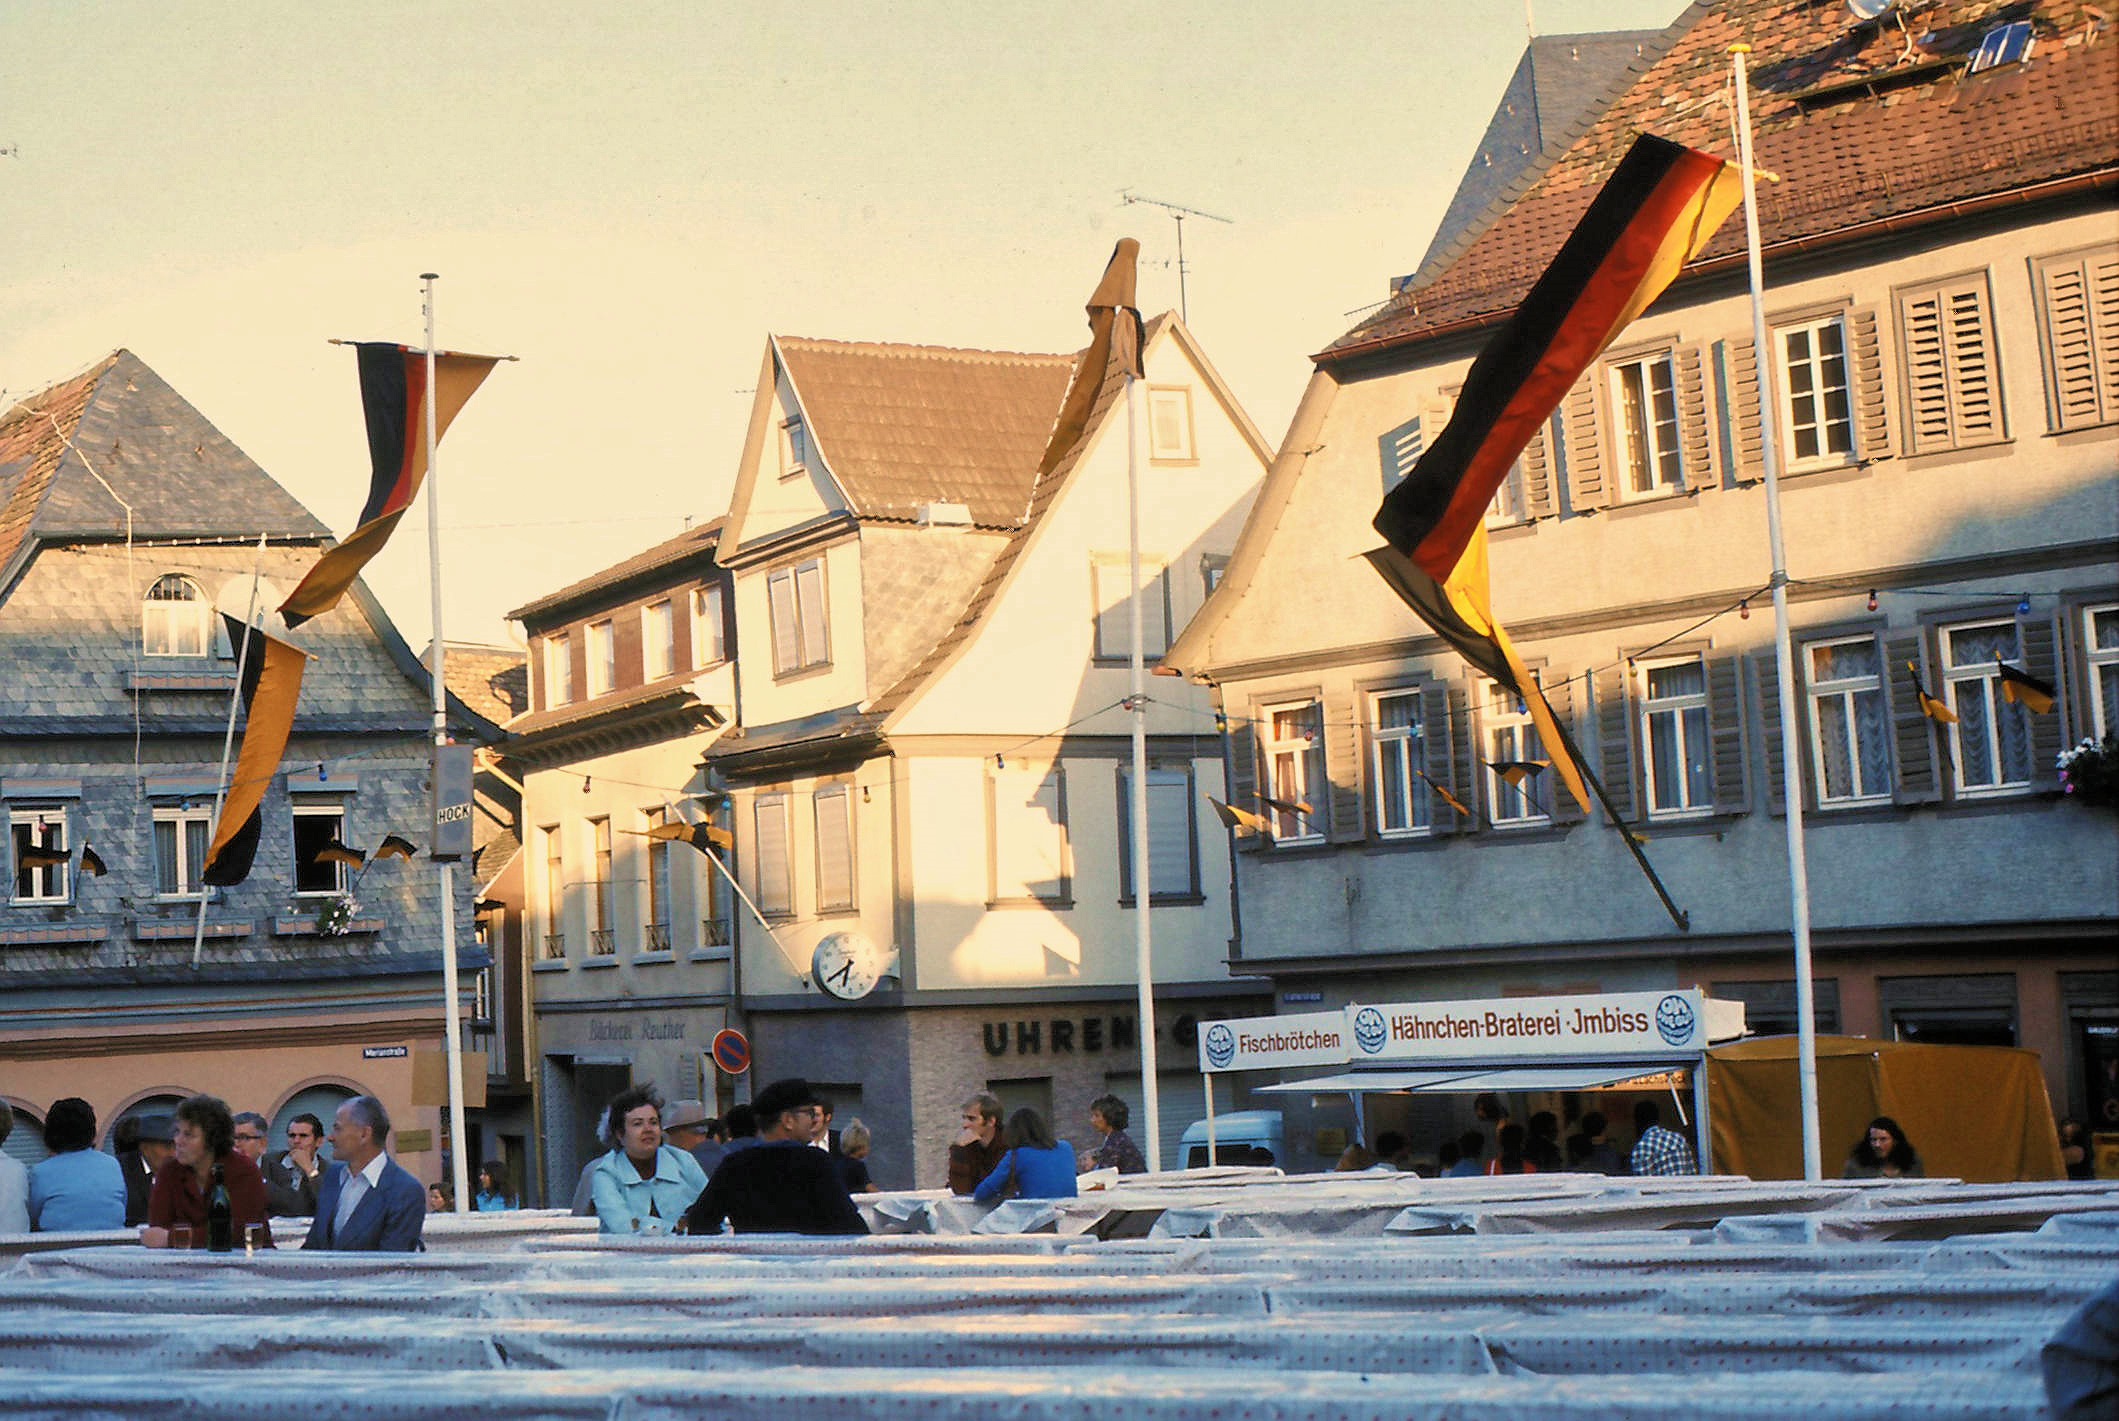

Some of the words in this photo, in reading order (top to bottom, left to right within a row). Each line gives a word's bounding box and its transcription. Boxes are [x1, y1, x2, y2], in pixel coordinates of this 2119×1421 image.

[438, 804, 470, 822] HOCK
[1391, 1009, 1561, 1040] Hähnchen-Braterei
[1239, 1030, 1341, 1053] Fischbrötchen
